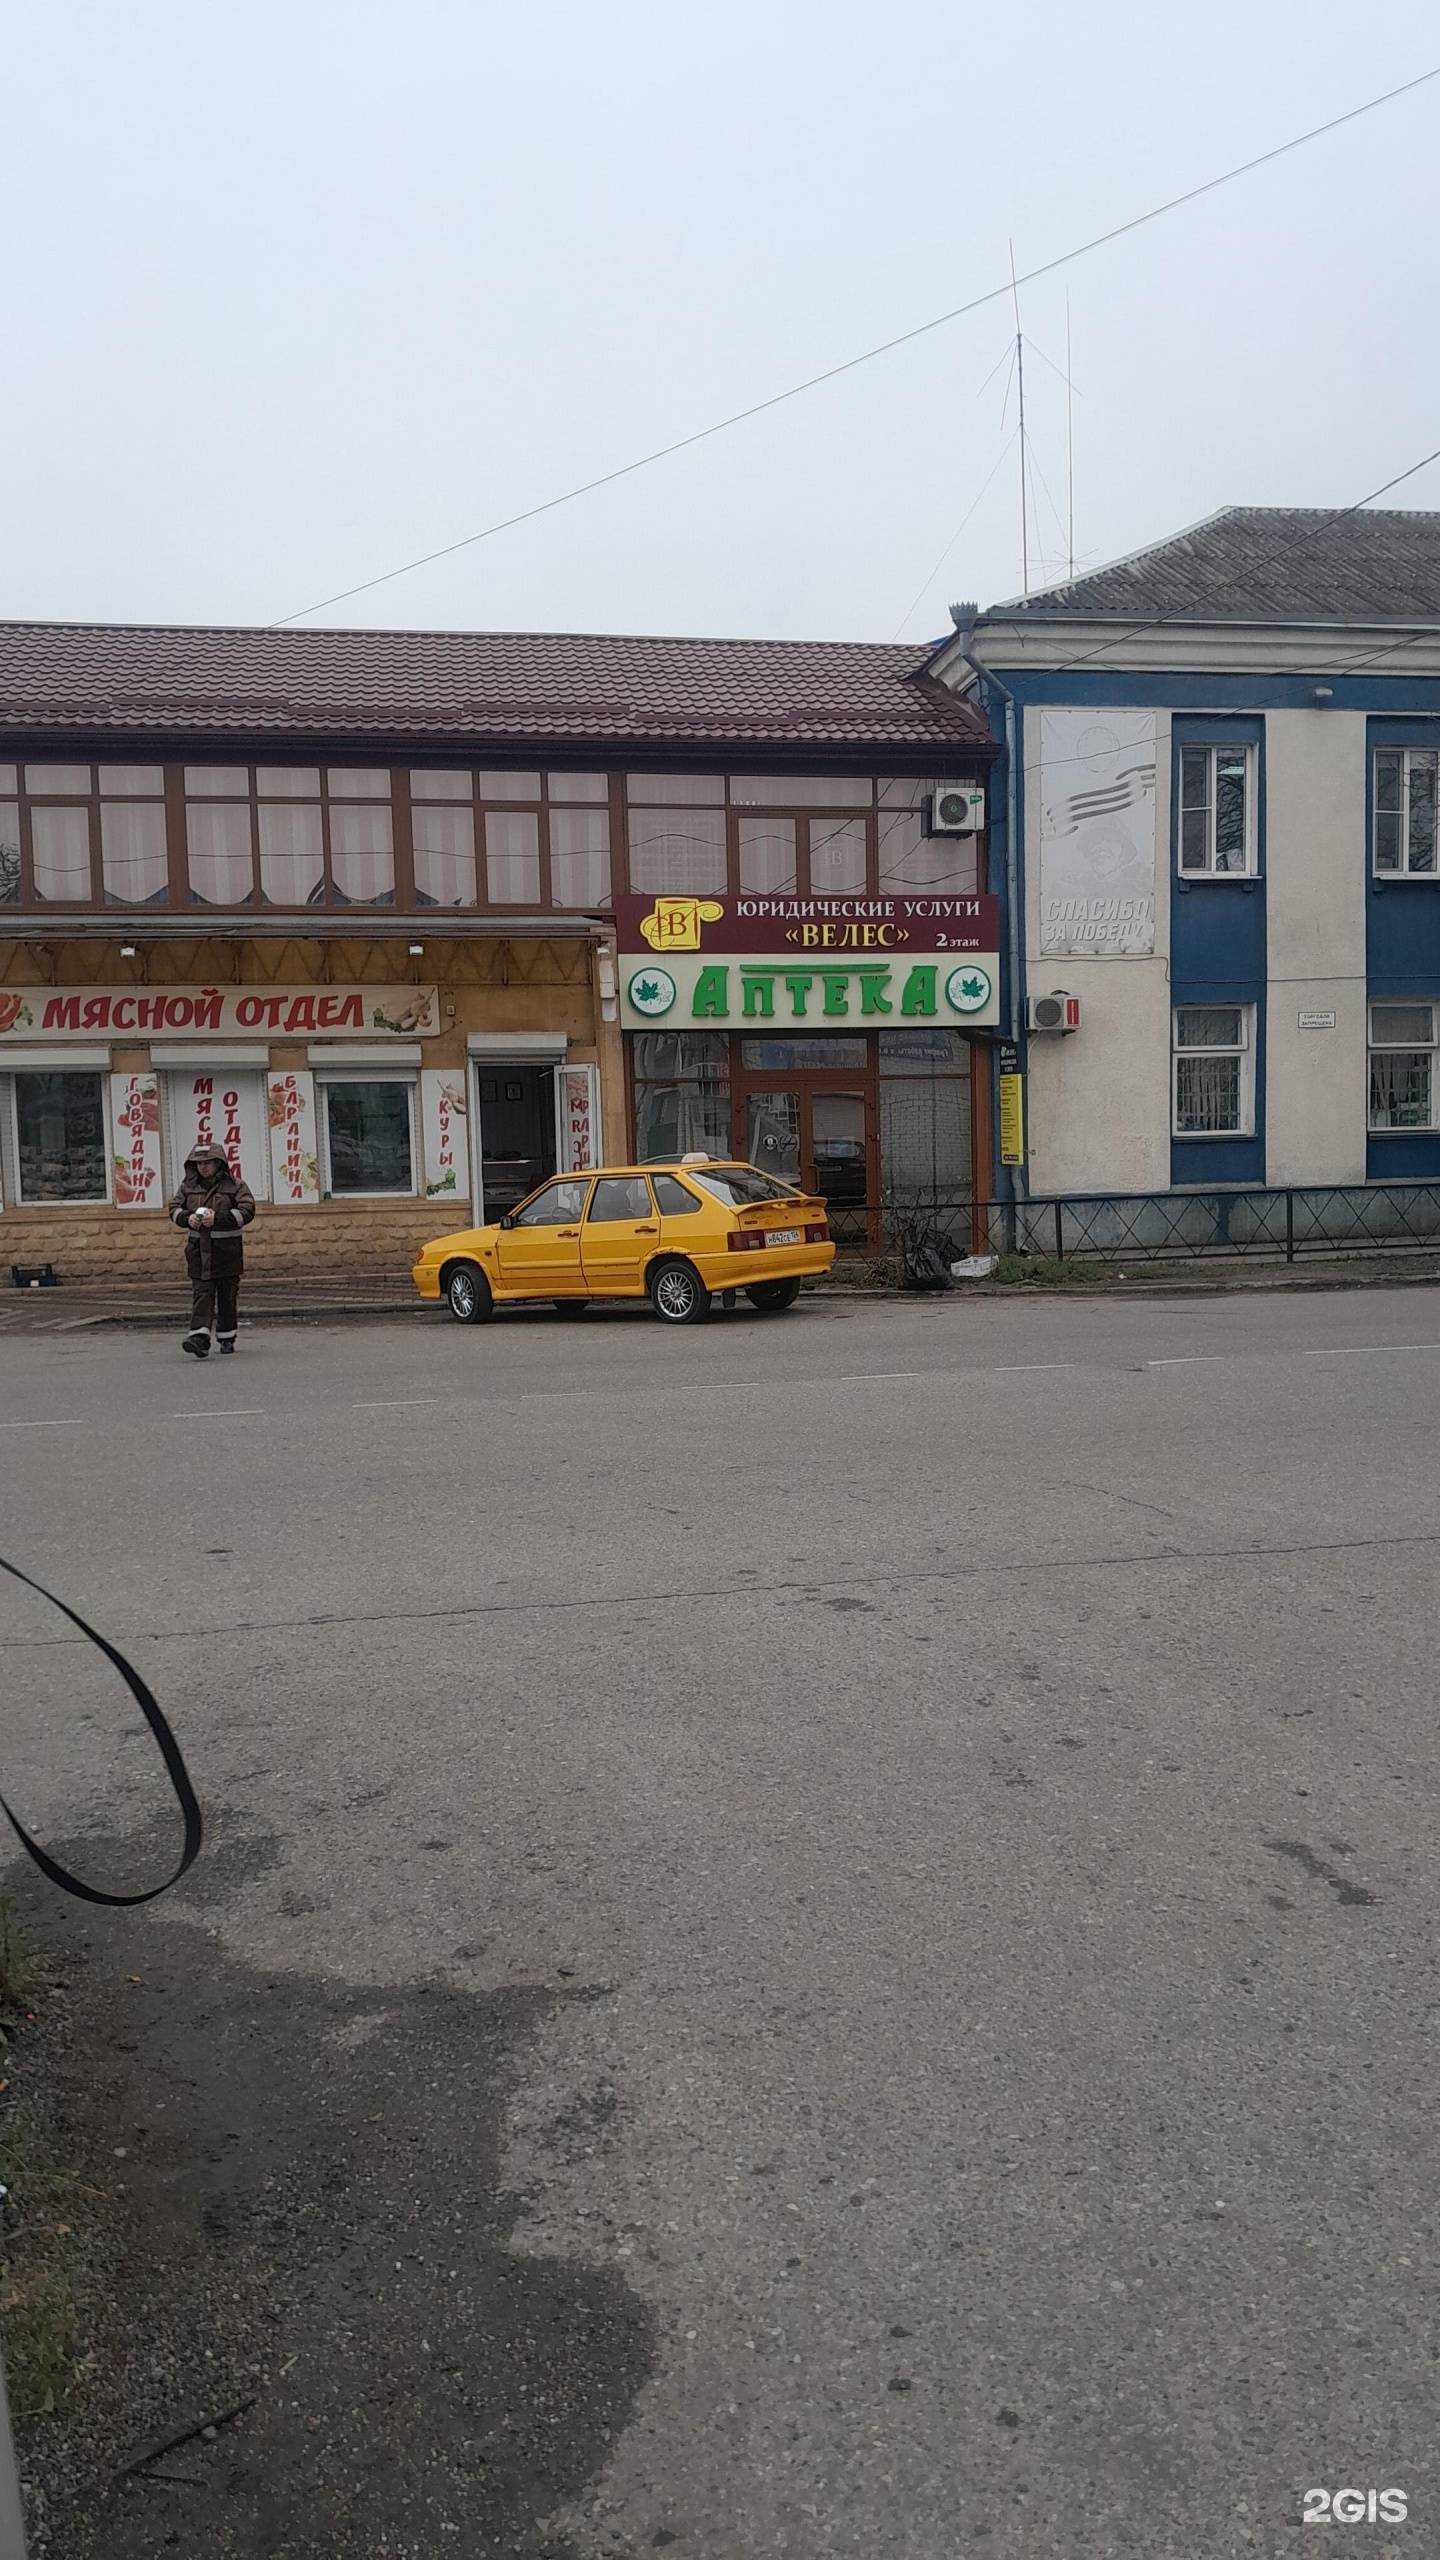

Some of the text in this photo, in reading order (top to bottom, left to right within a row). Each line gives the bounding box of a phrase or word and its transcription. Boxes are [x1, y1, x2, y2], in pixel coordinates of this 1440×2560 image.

[736, 901, 980, 918] ЮРИДИЧЕСКИЕ УСЛУГИ
[1046, 898, 1151, 921] СПАСИБО
[1046, 923, 1066, 941] ЗА
[785, 923, 910, 947] «ВЕЛЕС»
[935, 933, 980, 948] 2 этаж
[42, 987, 364, 1032] МЯСНОЙ ОТДЕЛ
[691, 965, 939, 1017] АПТЕКА
[193, 1078, 213, 1146] МЯСН
[439, 1101, 453, 1165] КУРЫ
[129, 1077, 146, 1202] ГОВЯДИНА
[285, 1075, 302, 1199] БАРАНИНА
